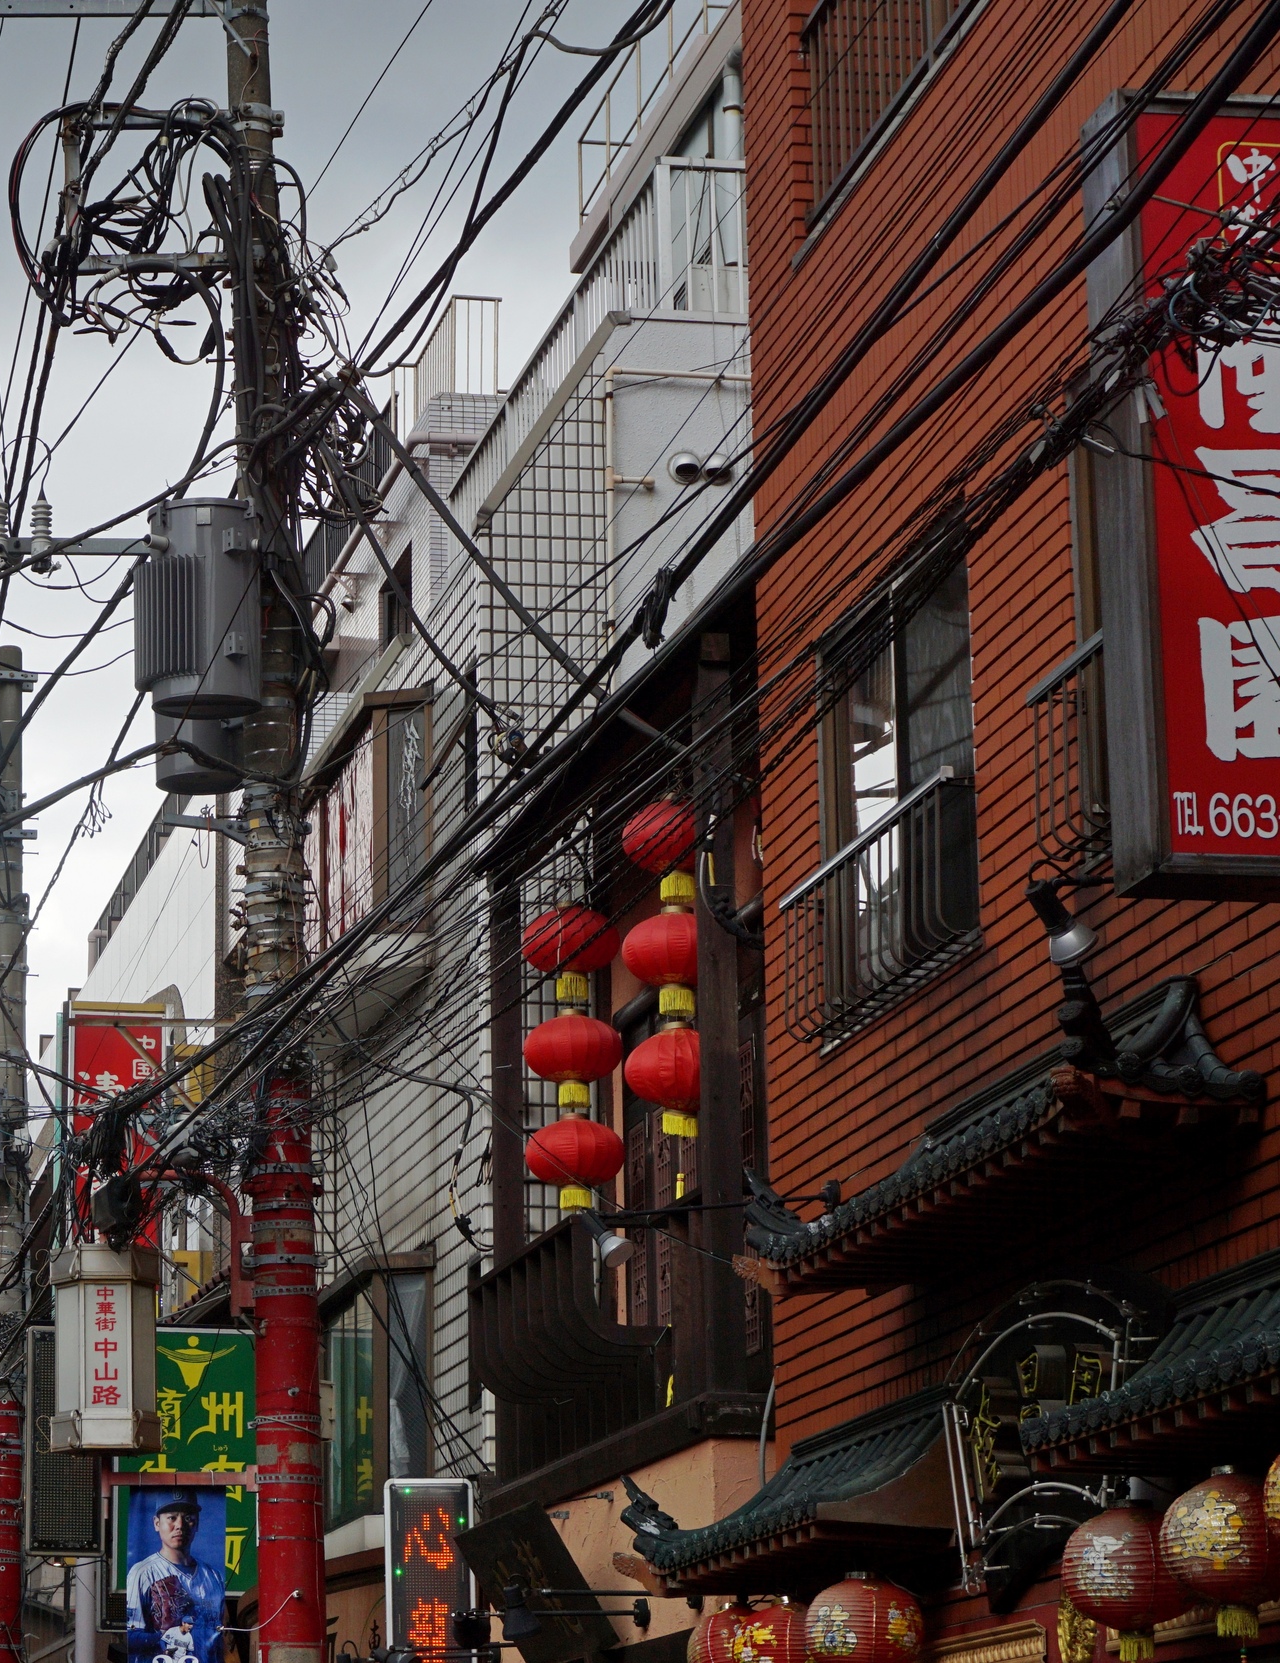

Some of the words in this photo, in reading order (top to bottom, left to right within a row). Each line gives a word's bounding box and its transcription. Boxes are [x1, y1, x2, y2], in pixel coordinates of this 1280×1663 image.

[1173, 791, 1204, 836] TEL
[1208, 792, 1280, 839] 663
[95, 1286, 117, 1332] 中華街
[92, 1338, 121, 1405] 中山路
